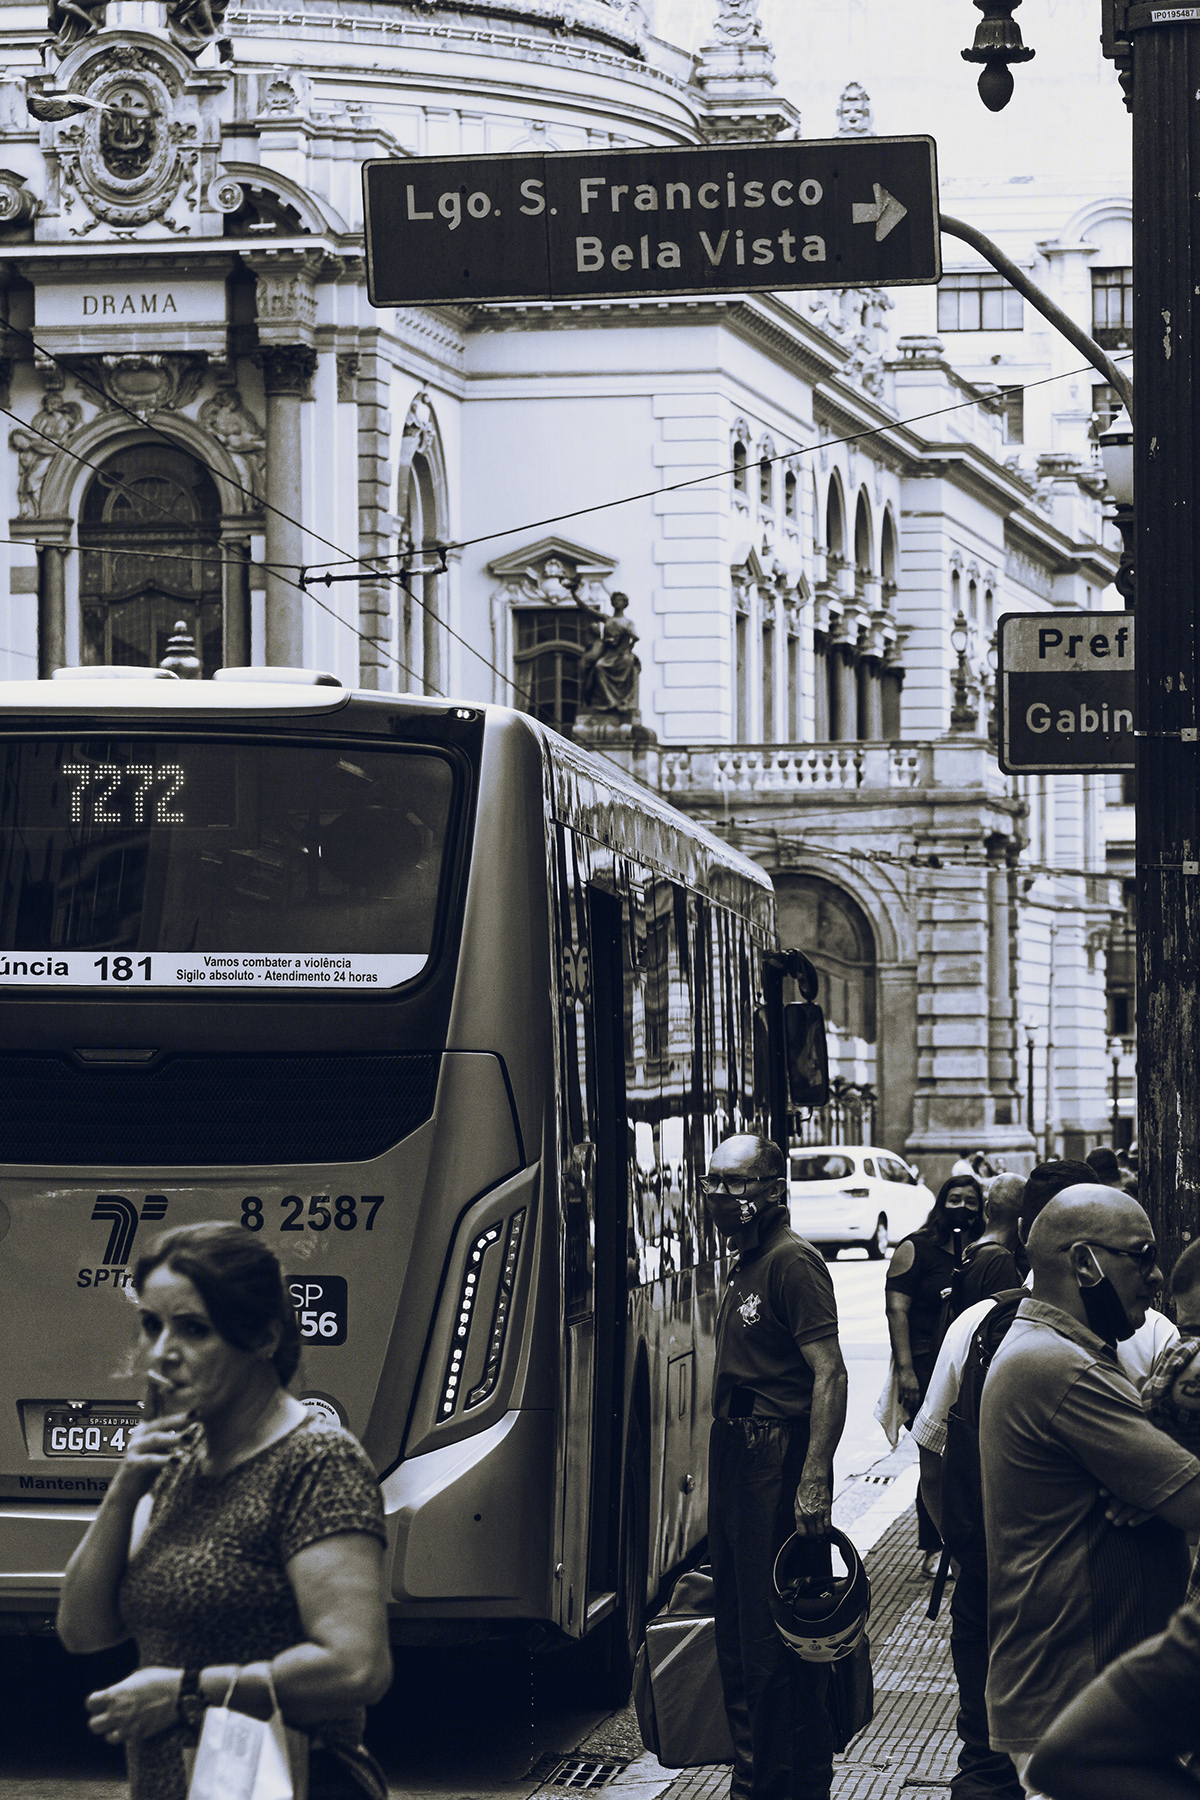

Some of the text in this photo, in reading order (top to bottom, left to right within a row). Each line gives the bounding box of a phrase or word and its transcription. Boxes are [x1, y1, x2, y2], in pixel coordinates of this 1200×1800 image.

[406, 171, 824, 231] Lgo. S. Francisco
[575, 228, 827, 273] Bela Vista
[83, 293, 178, 315] DRAMA
[1038, 627, 1129, 659] Pref
[1026, 702, 1134, 734] Gabin
[62, 764, 186, 823] 7272
[0, 956, 152, 982] úncia 181
[176, 969, 206, 983] Sigilo
[209, 969, 255, 981] absoluto
[264, 970, 331, 982] Atendimento
[333, 971, 346, 982] 24
[348, 971, 378, 983] horas
[203, 956, 352, 969] Vamos combater a violência
[240, 1195, 385, 1232] 8 2587
[288, 1283, 324, 1308] SP
[294, 1311, 338, 1338] 56
[19, 1476, 109, 1491] Mantenha
